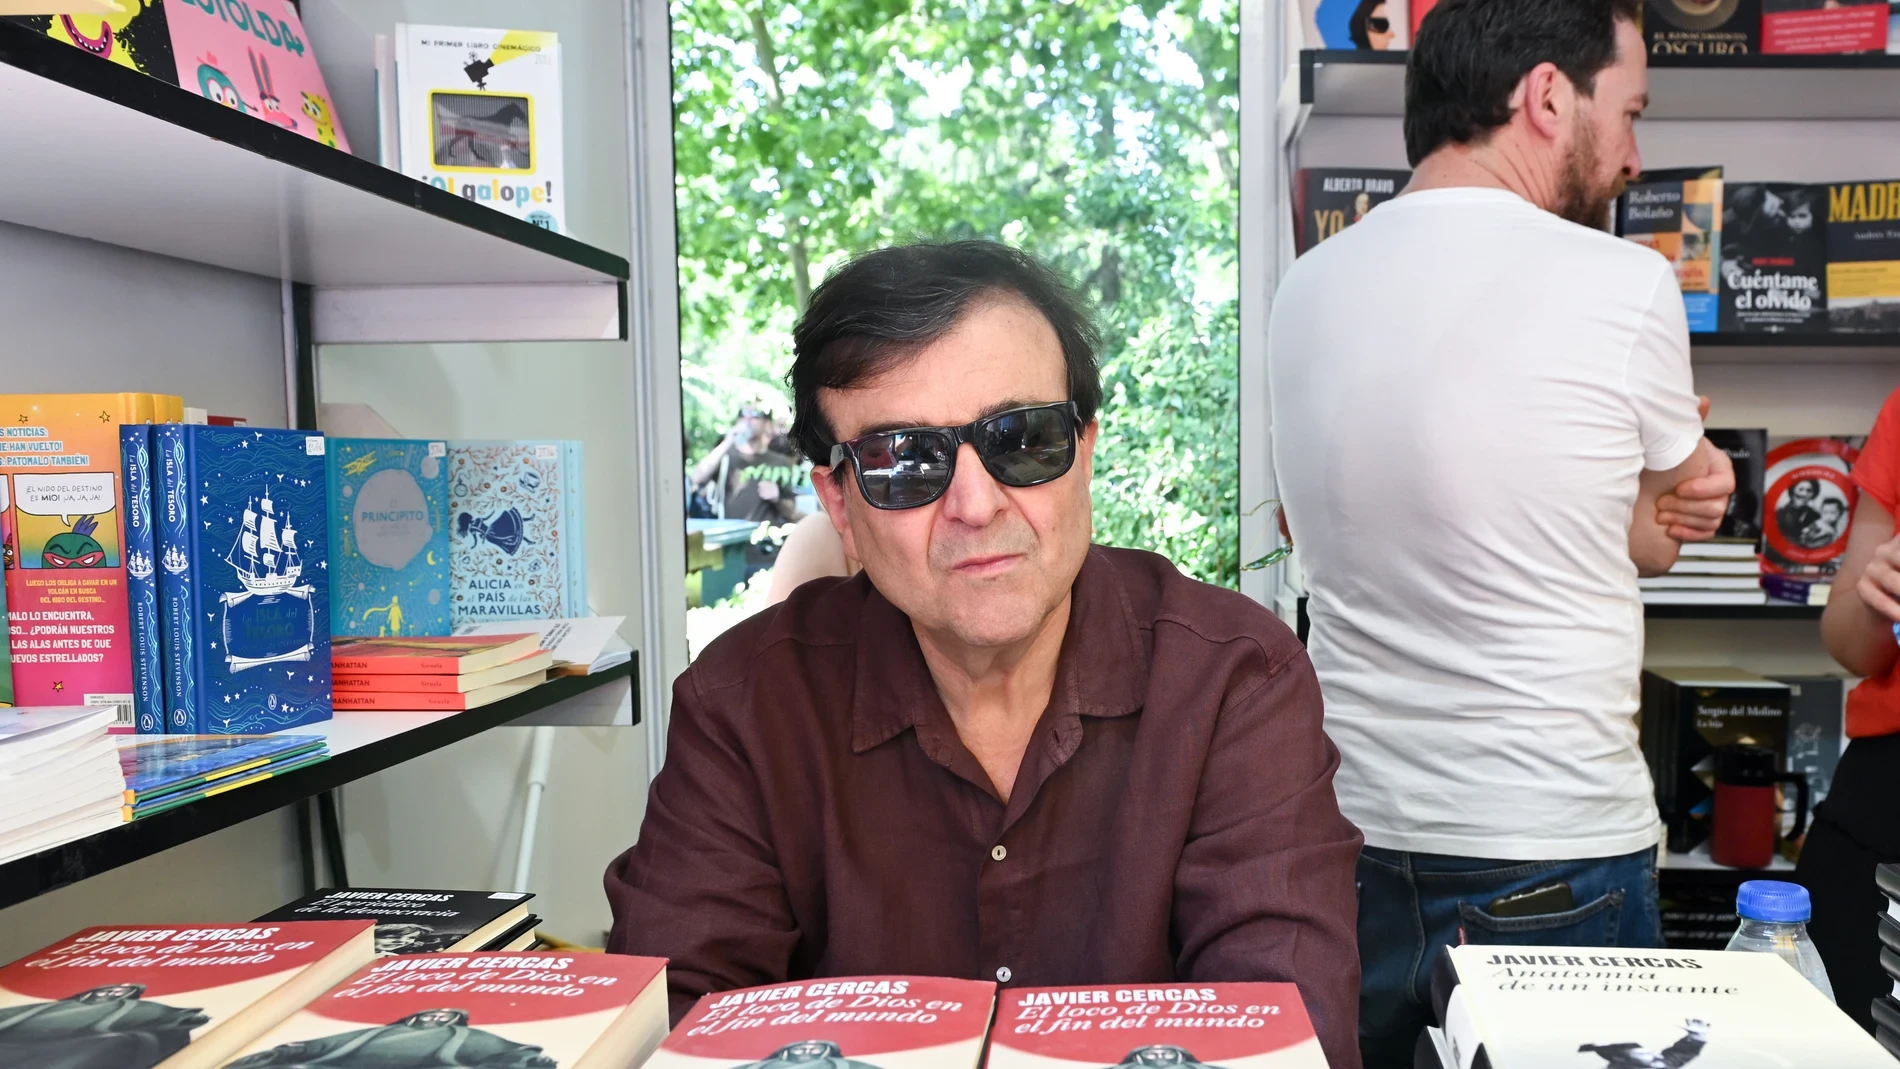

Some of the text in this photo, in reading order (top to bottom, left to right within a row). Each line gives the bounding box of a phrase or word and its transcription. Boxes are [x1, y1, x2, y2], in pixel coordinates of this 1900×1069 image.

[1668, 31, 1748, 41] RENACIMIENTO
[492, 43, 541, 52] CINEMÁGICO
[1323, 177, 1395, 193] ALBERTO BRAVO
[462, 178, 552, 208] galope!
[1628, 190, 1681, 203] Roberto
[1628, 205, 1674, 220] Bolaño
[1314, 209, 1345, 242] YO
[1727, 268, 1818, 291] Cuéntame
[1735, 288, 1753, 310] el
[1755, 288, 1812, 311] olvido
[7, 428, 47, 437] NOTICIAS:
[9, 442, 26, 451] HAN
[28, 442, 62, 451] VUELTO!
[7, 457, 49, 466] PATOMALO
[51, 454, 88, 465] TAMBIÉN!
[131, 495, 140, 528] TESORO
[167, 489, 176, 523] TESORO
[361, 510, 424, 523] PRINCIPITO
[469, 579, 511, 589] ALICIA
[478, 590, 505, 602] PAÍS
[508, 594, 517, 602] de
[519, 594, 531, 602] las
[29, 611, 94, 621] LO ENCUENTRA,
[458, 605, 541, 615] MARAVILLAS
[30, 623, 115, 635] ¿PODRÁN NUESTROS
[11, 639, 111, 649] LAS ALAS ANTES DE QUE
[39, 653, 104, 663] ESTRELLADOS?
[140, 656, 148, 702] STEVENSON
[174, 652, 182, 697] STEVENSON
[1697, 705, 1782, 718] Sergio del Molino
[324, 891, 454, 902] JAVIER CERCAS
[331, 900, 426, 909] periódico
[344, 907, 460, 917] democracia
[75, 927, 280, 943] JAVIER CERCAS
[50, 941, 315, 955] El loco de Dios en
[24, 955, 63, 968] el
[107, 954, 166, 968] del
[160, 952, 275, 967] mundo
[370, 956, 574, 973] JAVIER CERCAS
[1486, 954, 1704, 969] JAVIER CERCAS
[351, 968, 618, 986] El loco de Dios en
[1492, 967, 1658, 981] Anatomía
[333, 980, 584, 999] el fin del mundo
[709, 981, 909, 1009] JAVIER CERCAS
[1498, 980, 1741, 995] de un instante
[1018, 988, 1217, 1007] JAVIER CERCAS
[697, 995, 963, 1023] El loco de Dios en
[1014, 1001, 1281, 1020] El loco de Dios en
[687, 1010, 938, 1037] el fin del mundo
[1014, 1015, 1265, 1036] el fin del mundo
